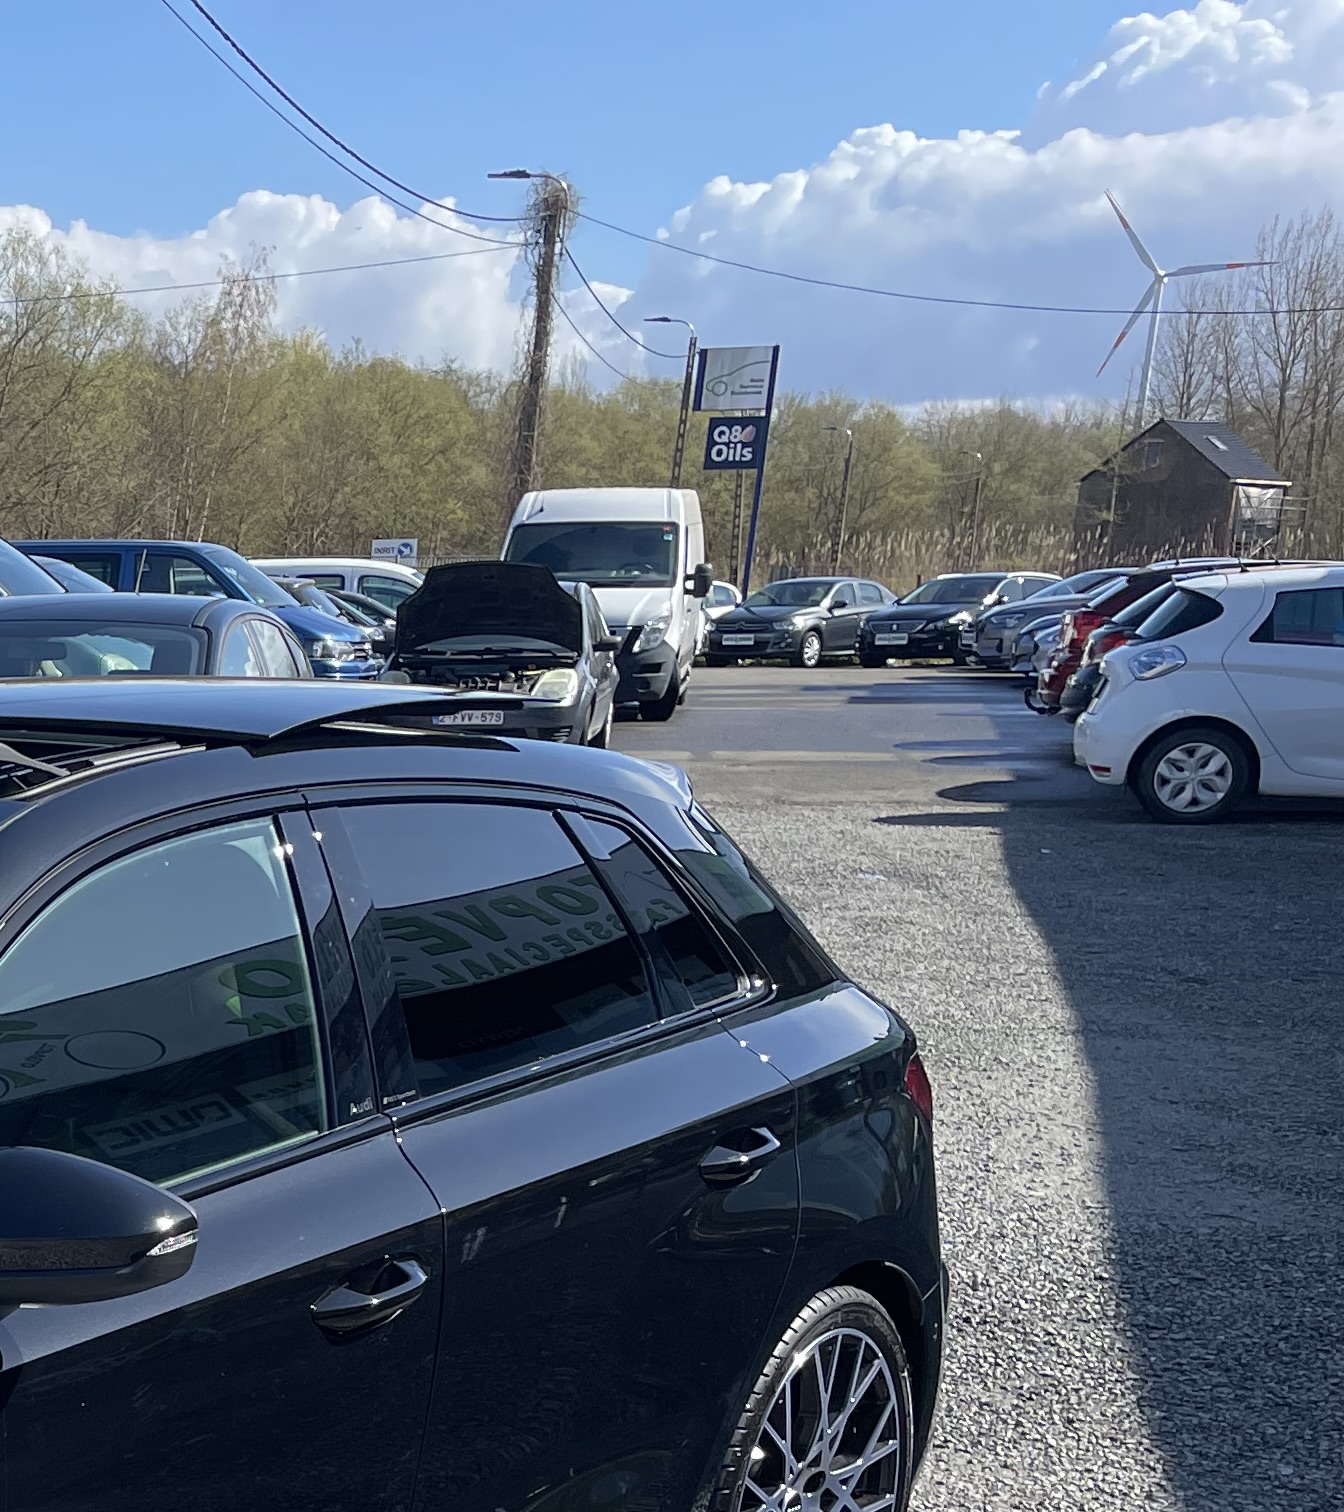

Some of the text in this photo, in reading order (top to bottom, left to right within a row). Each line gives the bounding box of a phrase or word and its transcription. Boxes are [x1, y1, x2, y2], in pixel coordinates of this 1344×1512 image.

[713, 425, 742, 443] Q8
[710, 443, 753, 462] Oils
[350, 1096, 374, 1117] Audi
